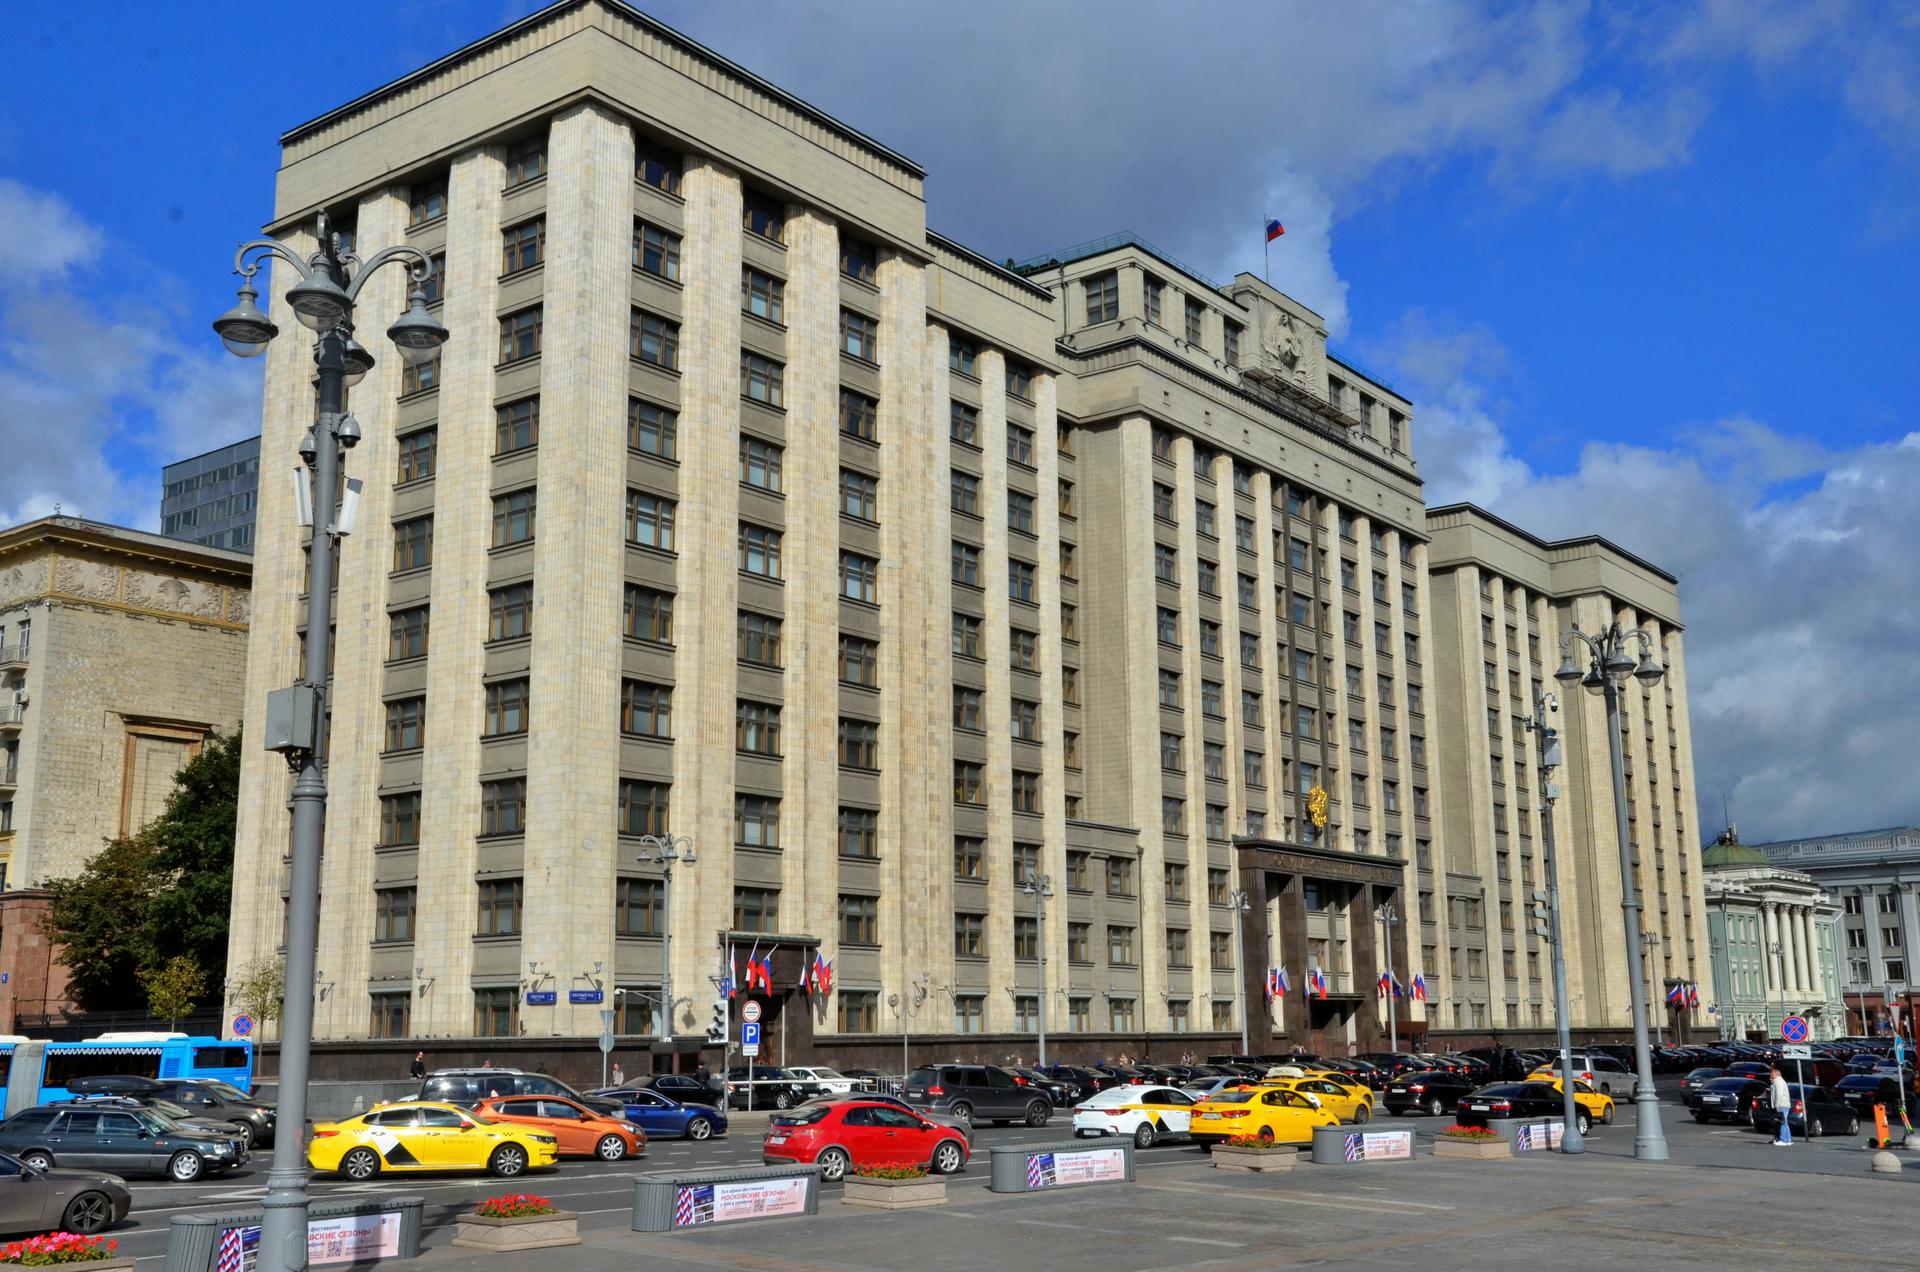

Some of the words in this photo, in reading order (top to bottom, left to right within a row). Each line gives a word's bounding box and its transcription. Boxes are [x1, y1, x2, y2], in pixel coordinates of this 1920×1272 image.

[746, 1026, 756, 1042] P
[721, 1192, 760, 1201] МОСКОВСКИЕ
[762, 1190, 786, 1199] СЕЗОНЫ
[308, 1232, 336, 1241] ВСКИЕ
[338, 1229, 370, 1238] СЕЗОНЫ
